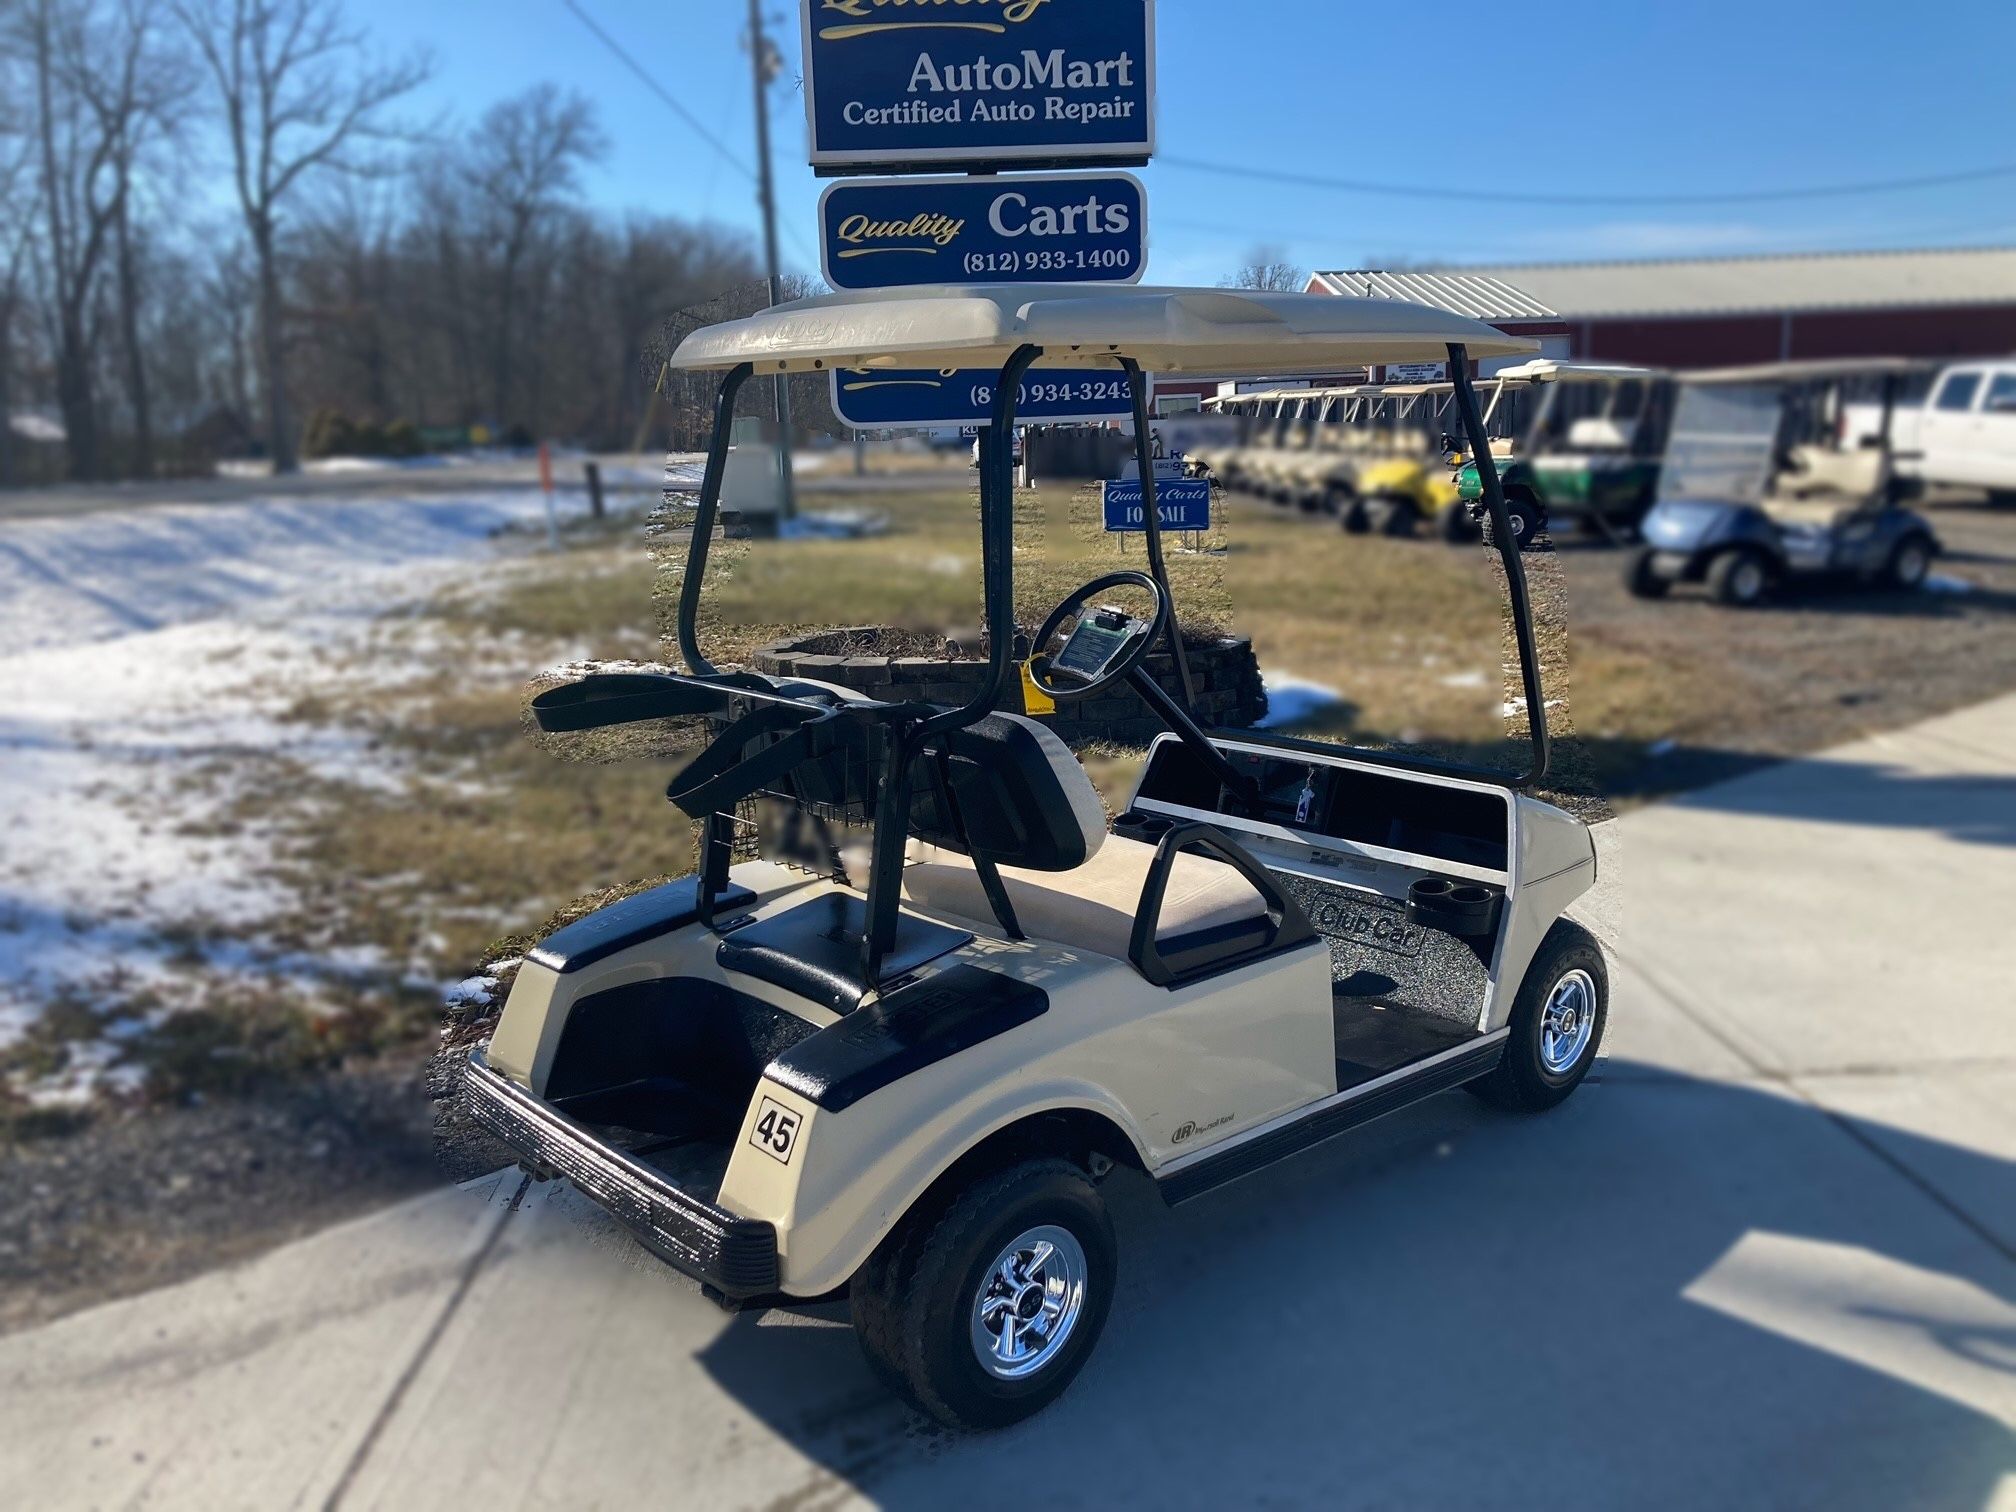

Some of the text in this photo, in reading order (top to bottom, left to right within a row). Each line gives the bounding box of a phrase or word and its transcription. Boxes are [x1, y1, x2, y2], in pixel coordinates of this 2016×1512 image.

[907, 49, 1133, 92] AutoMart
[843, 96, 1135, 125] Certified Auto Repair
[837, 192, 1130, 246] Quality Carts
[963, 248, 1130, 273] (812) 933-1400
[970, 381, 1132, 406] (8) 934-3243
[1165, 488, 1207, 500] Carts
[1126, 505, 1187, 523] FO SALE
[1319, 904, 1416, 946] Club Car
[757, 1109, 796, 1153] 45
